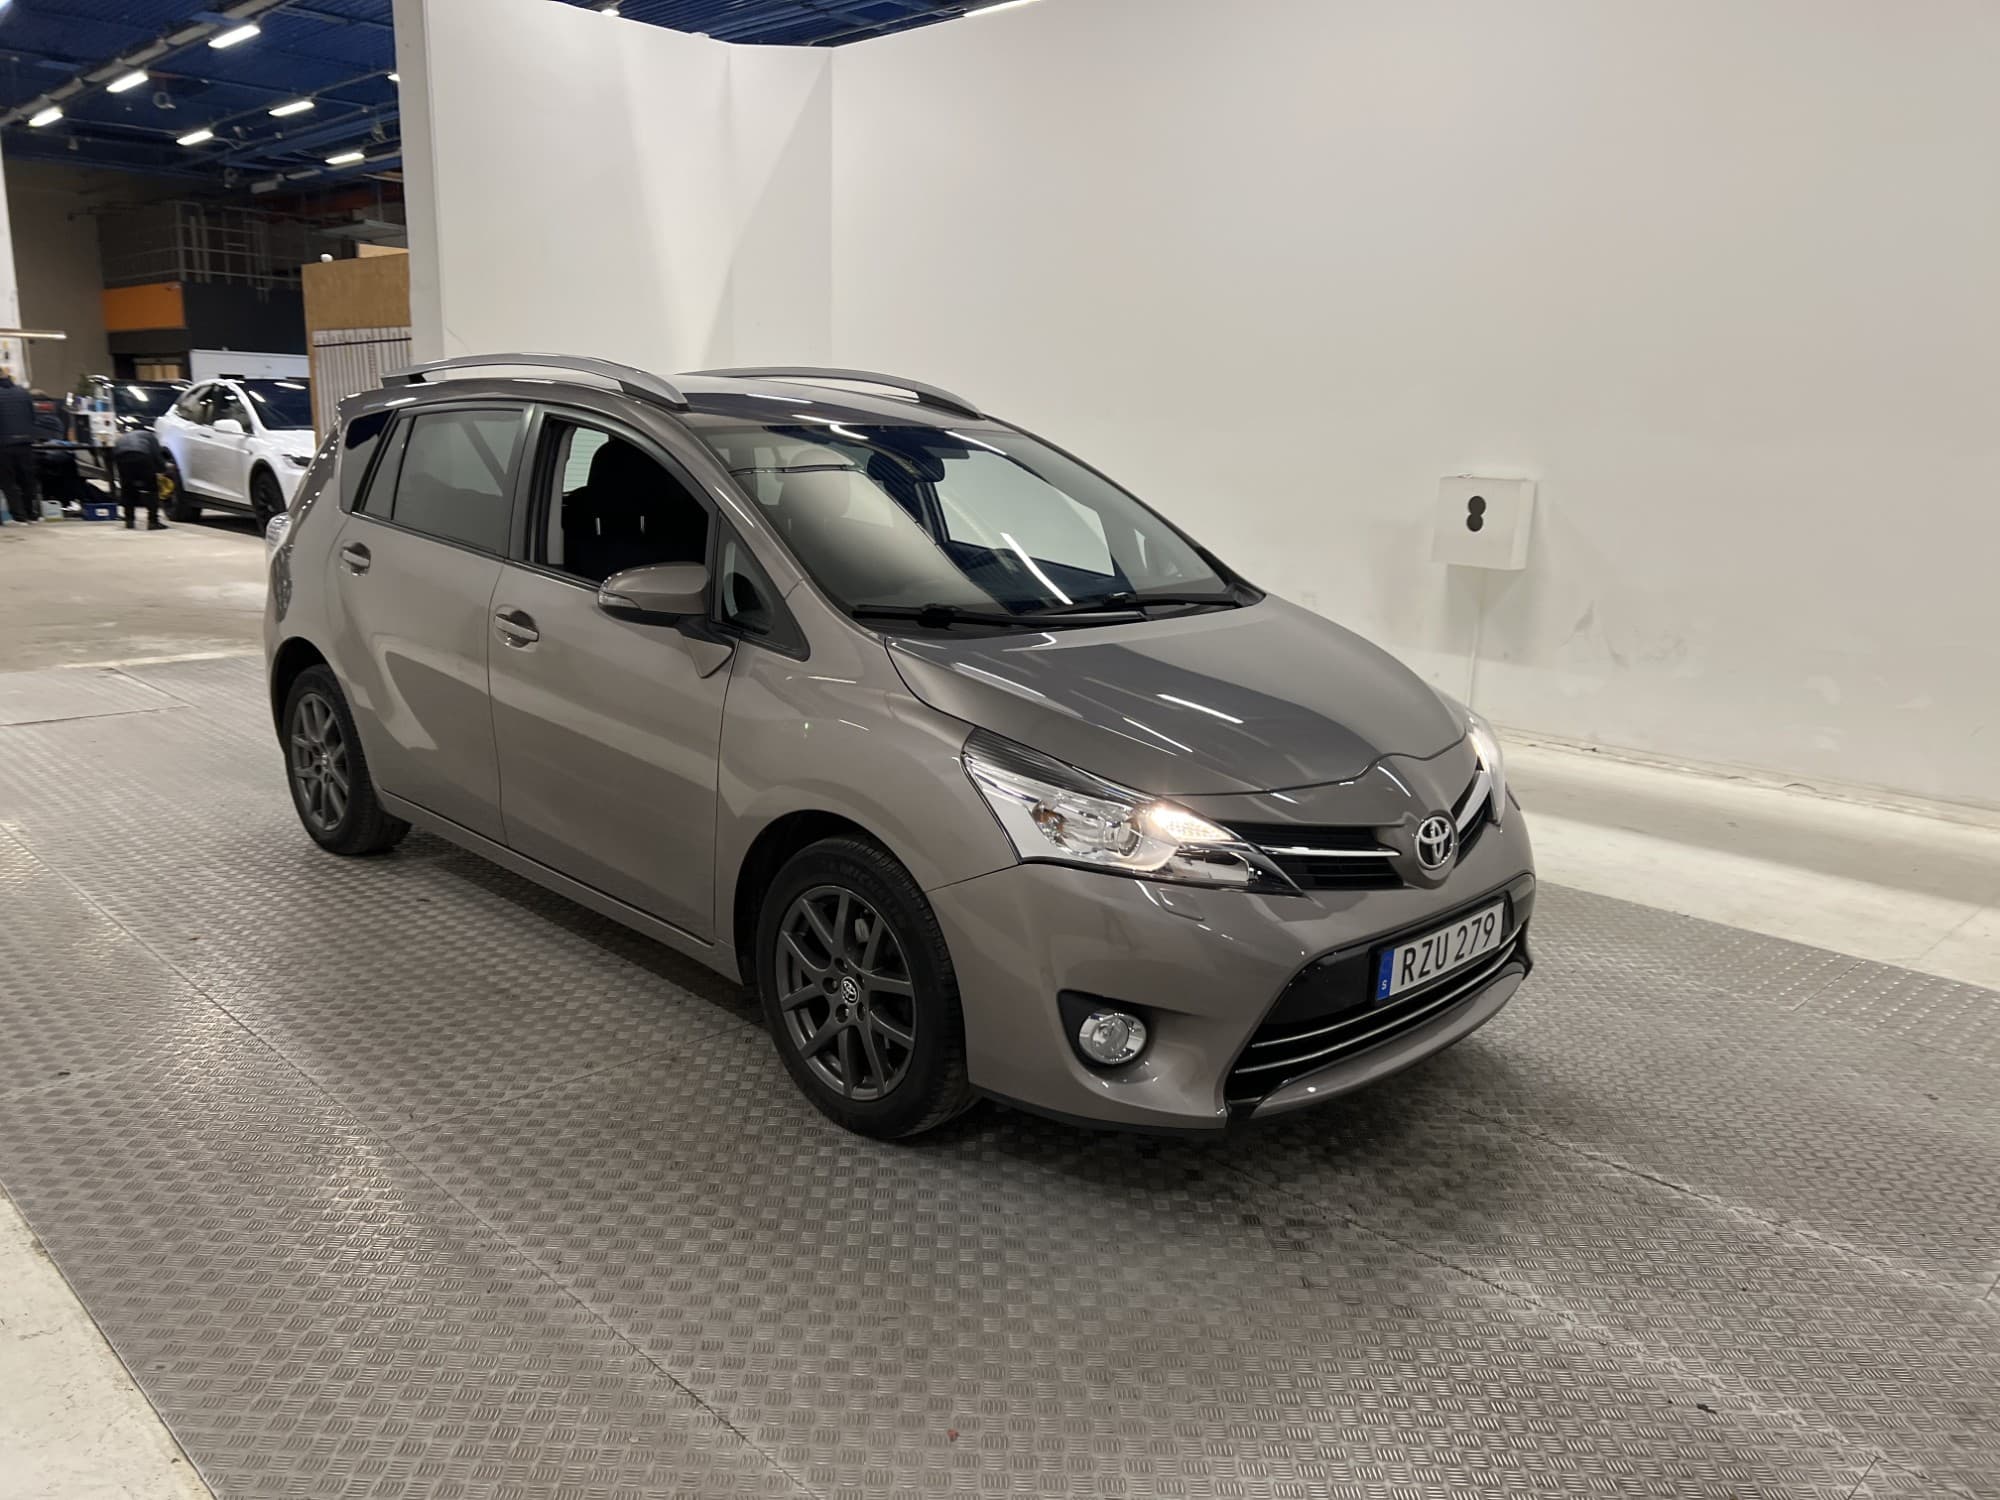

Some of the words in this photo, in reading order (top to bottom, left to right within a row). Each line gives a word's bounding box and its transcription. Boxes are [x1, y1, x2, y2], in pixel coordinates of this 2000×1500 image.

[1401, 932, 1449, 985] RZU
[1454, 912, 1496, 962] 279
[1381, 979, 1388, 990] S
